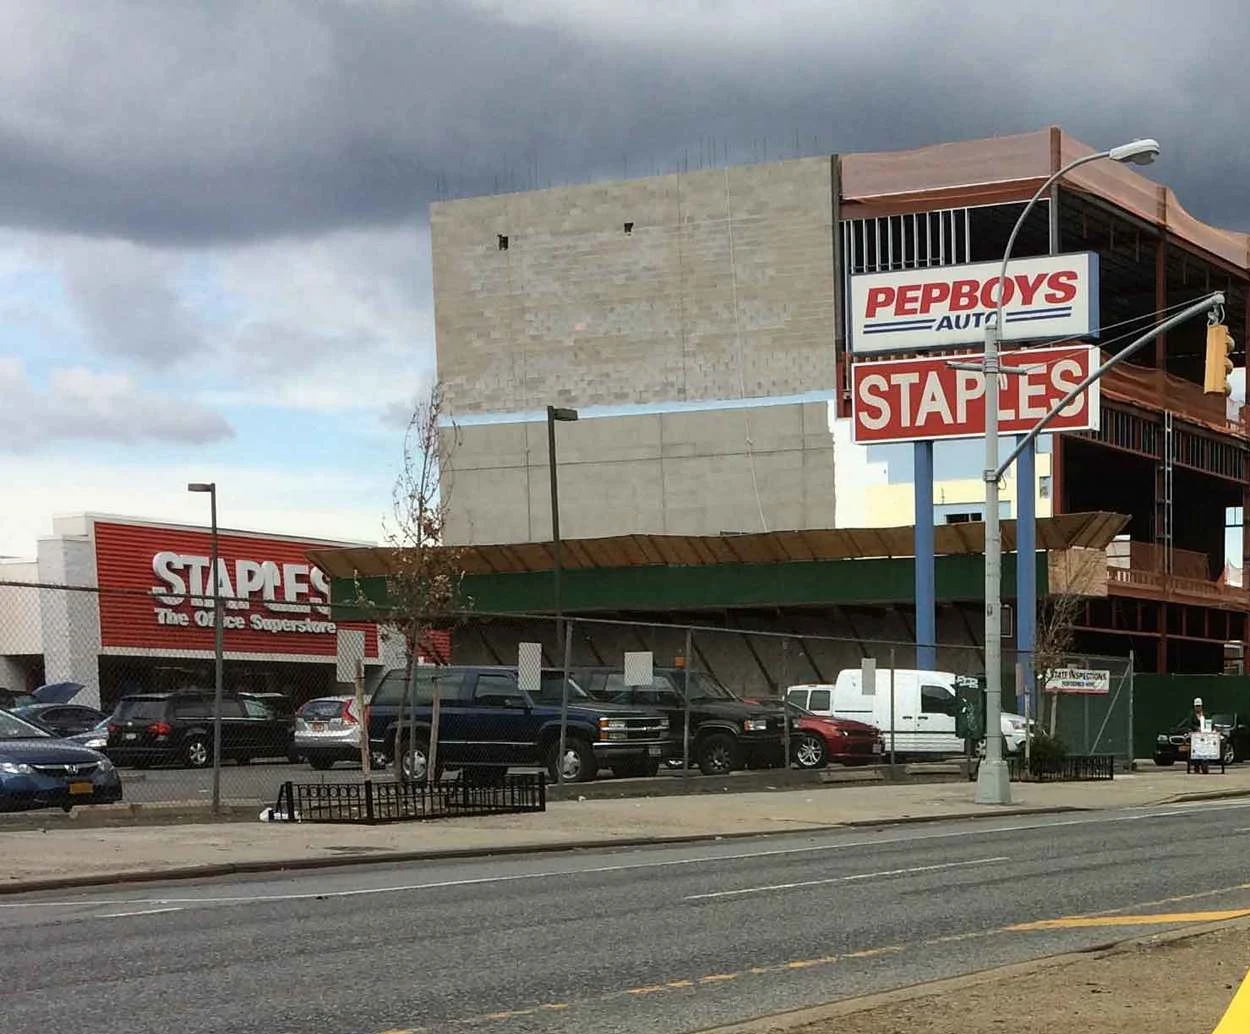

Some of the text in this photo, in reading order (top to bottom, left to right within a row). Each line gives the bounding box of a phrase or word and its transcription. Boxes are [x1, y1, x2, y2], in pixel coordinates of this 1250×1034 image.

[865, 270, 1078, 318] PEPBOYS
[152, 551, 331, 615] STAPLES
[154, 607, 337, 634] The Ofice Superstore
